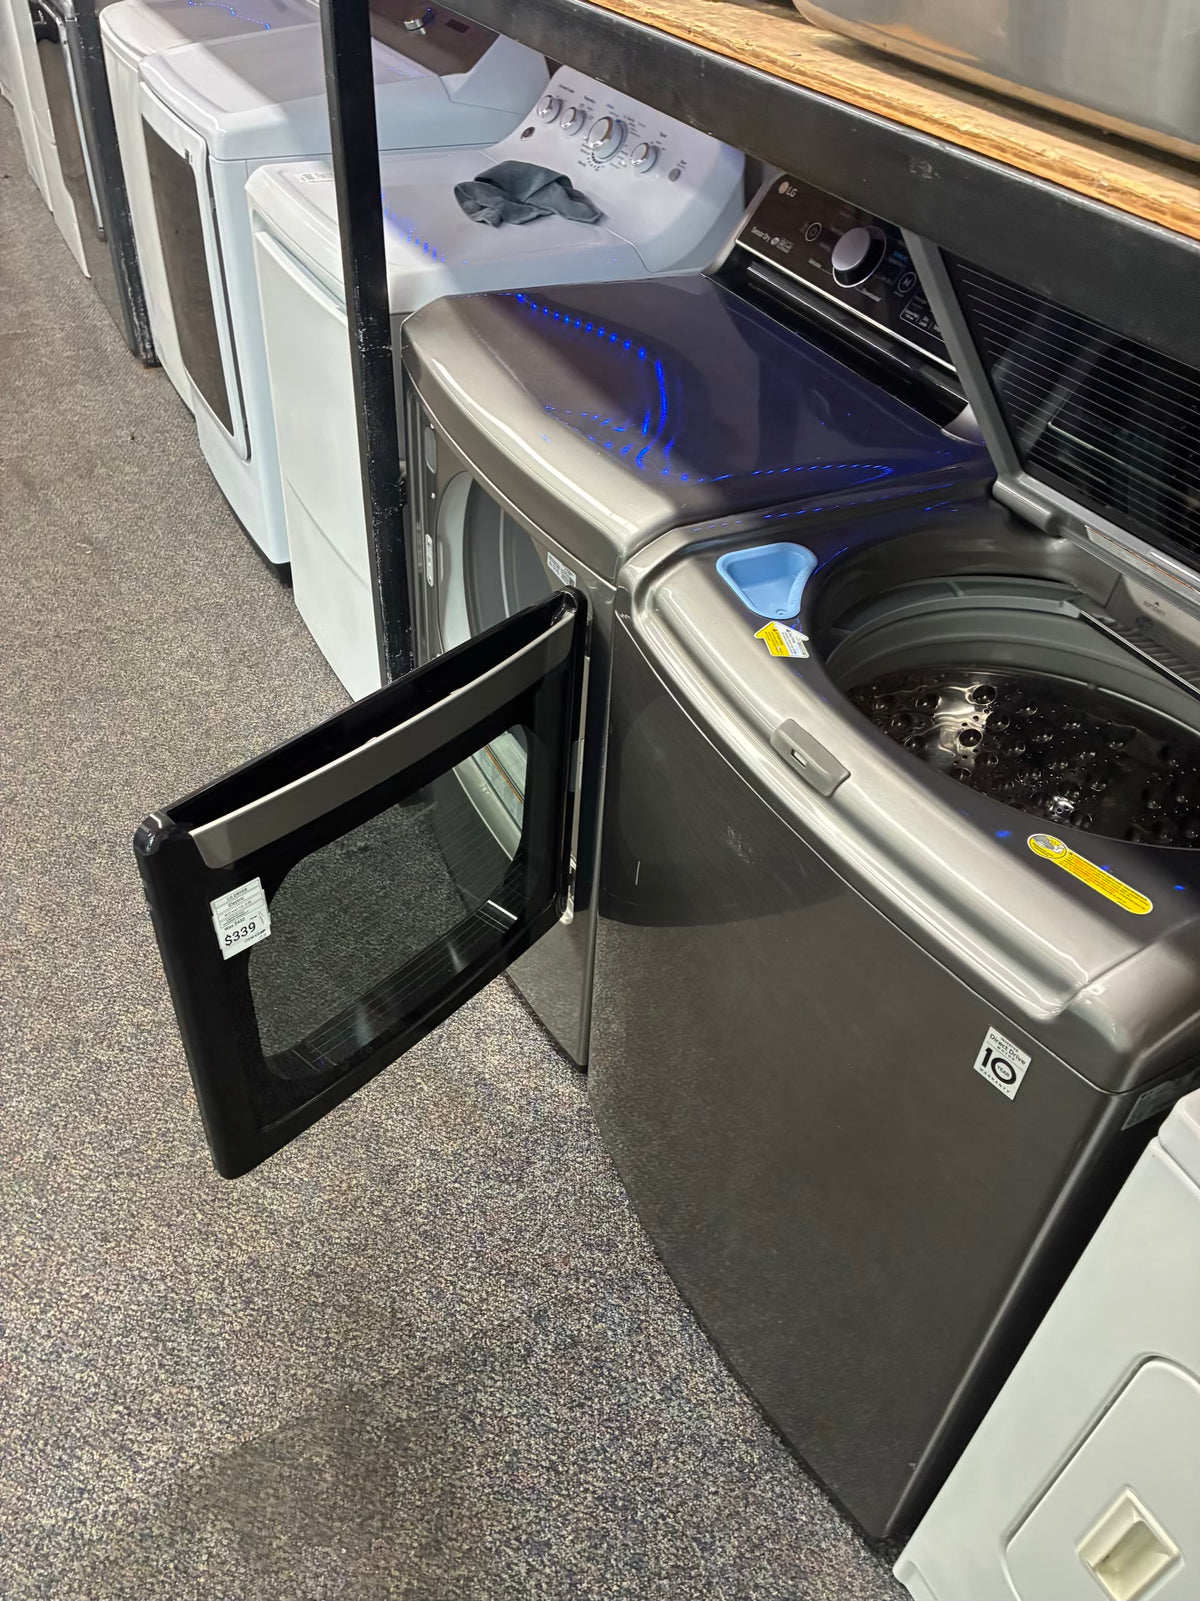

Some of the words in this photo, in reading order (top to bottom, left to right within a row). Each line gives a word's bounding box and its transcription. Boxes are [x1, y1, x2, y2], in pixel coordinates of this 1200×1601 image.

[786, 186, 798, 198] LG
[224, 921, 256, 946] $339
[989, 1033, 1008, 1051] Direct
[1008, 1048, 1026, 1065] Drive
[981, 1047, 1017, 1085] 10
[996, 1065, 1011, 1079] YEAR
[979, 1067, 1010, 1093] WARRANTY
